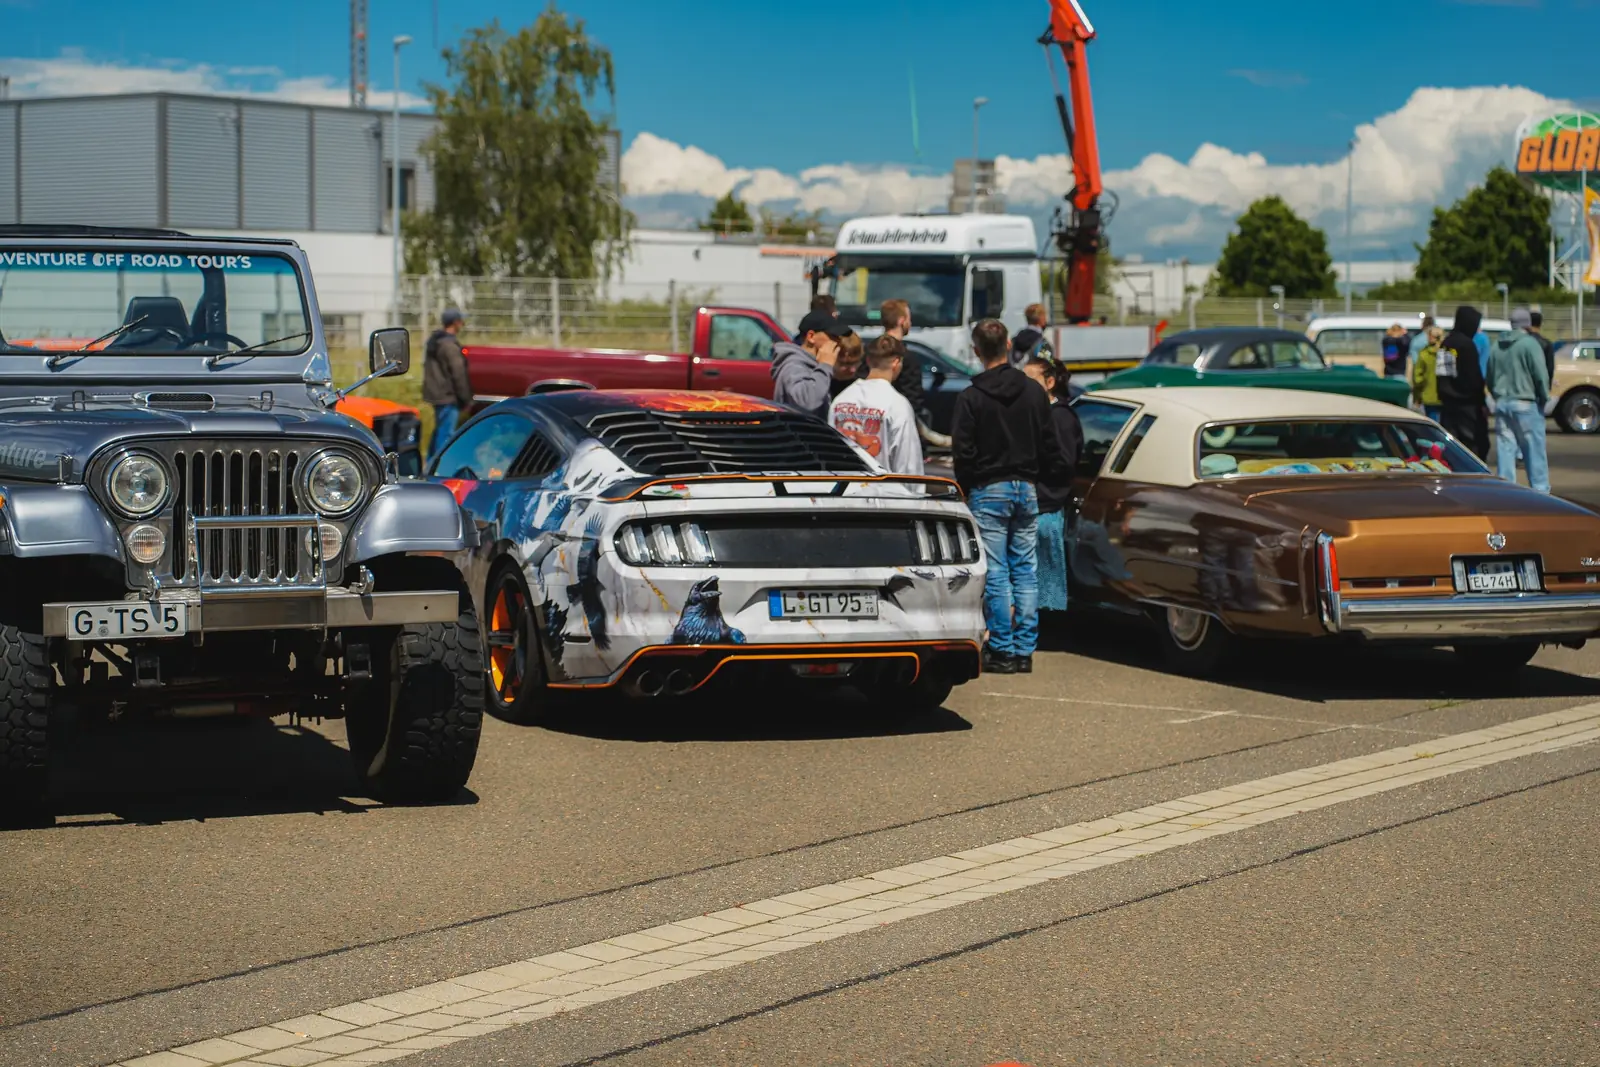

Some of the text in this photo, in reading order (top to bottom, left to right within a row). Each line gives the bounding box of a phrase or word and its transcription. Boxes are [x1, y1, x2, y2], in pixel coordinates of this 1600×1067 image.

[1517, 127, 1600, 172] GLOB
[92, 252, 125, 267] OFF
[131, 254, 183, 267] ROAD
